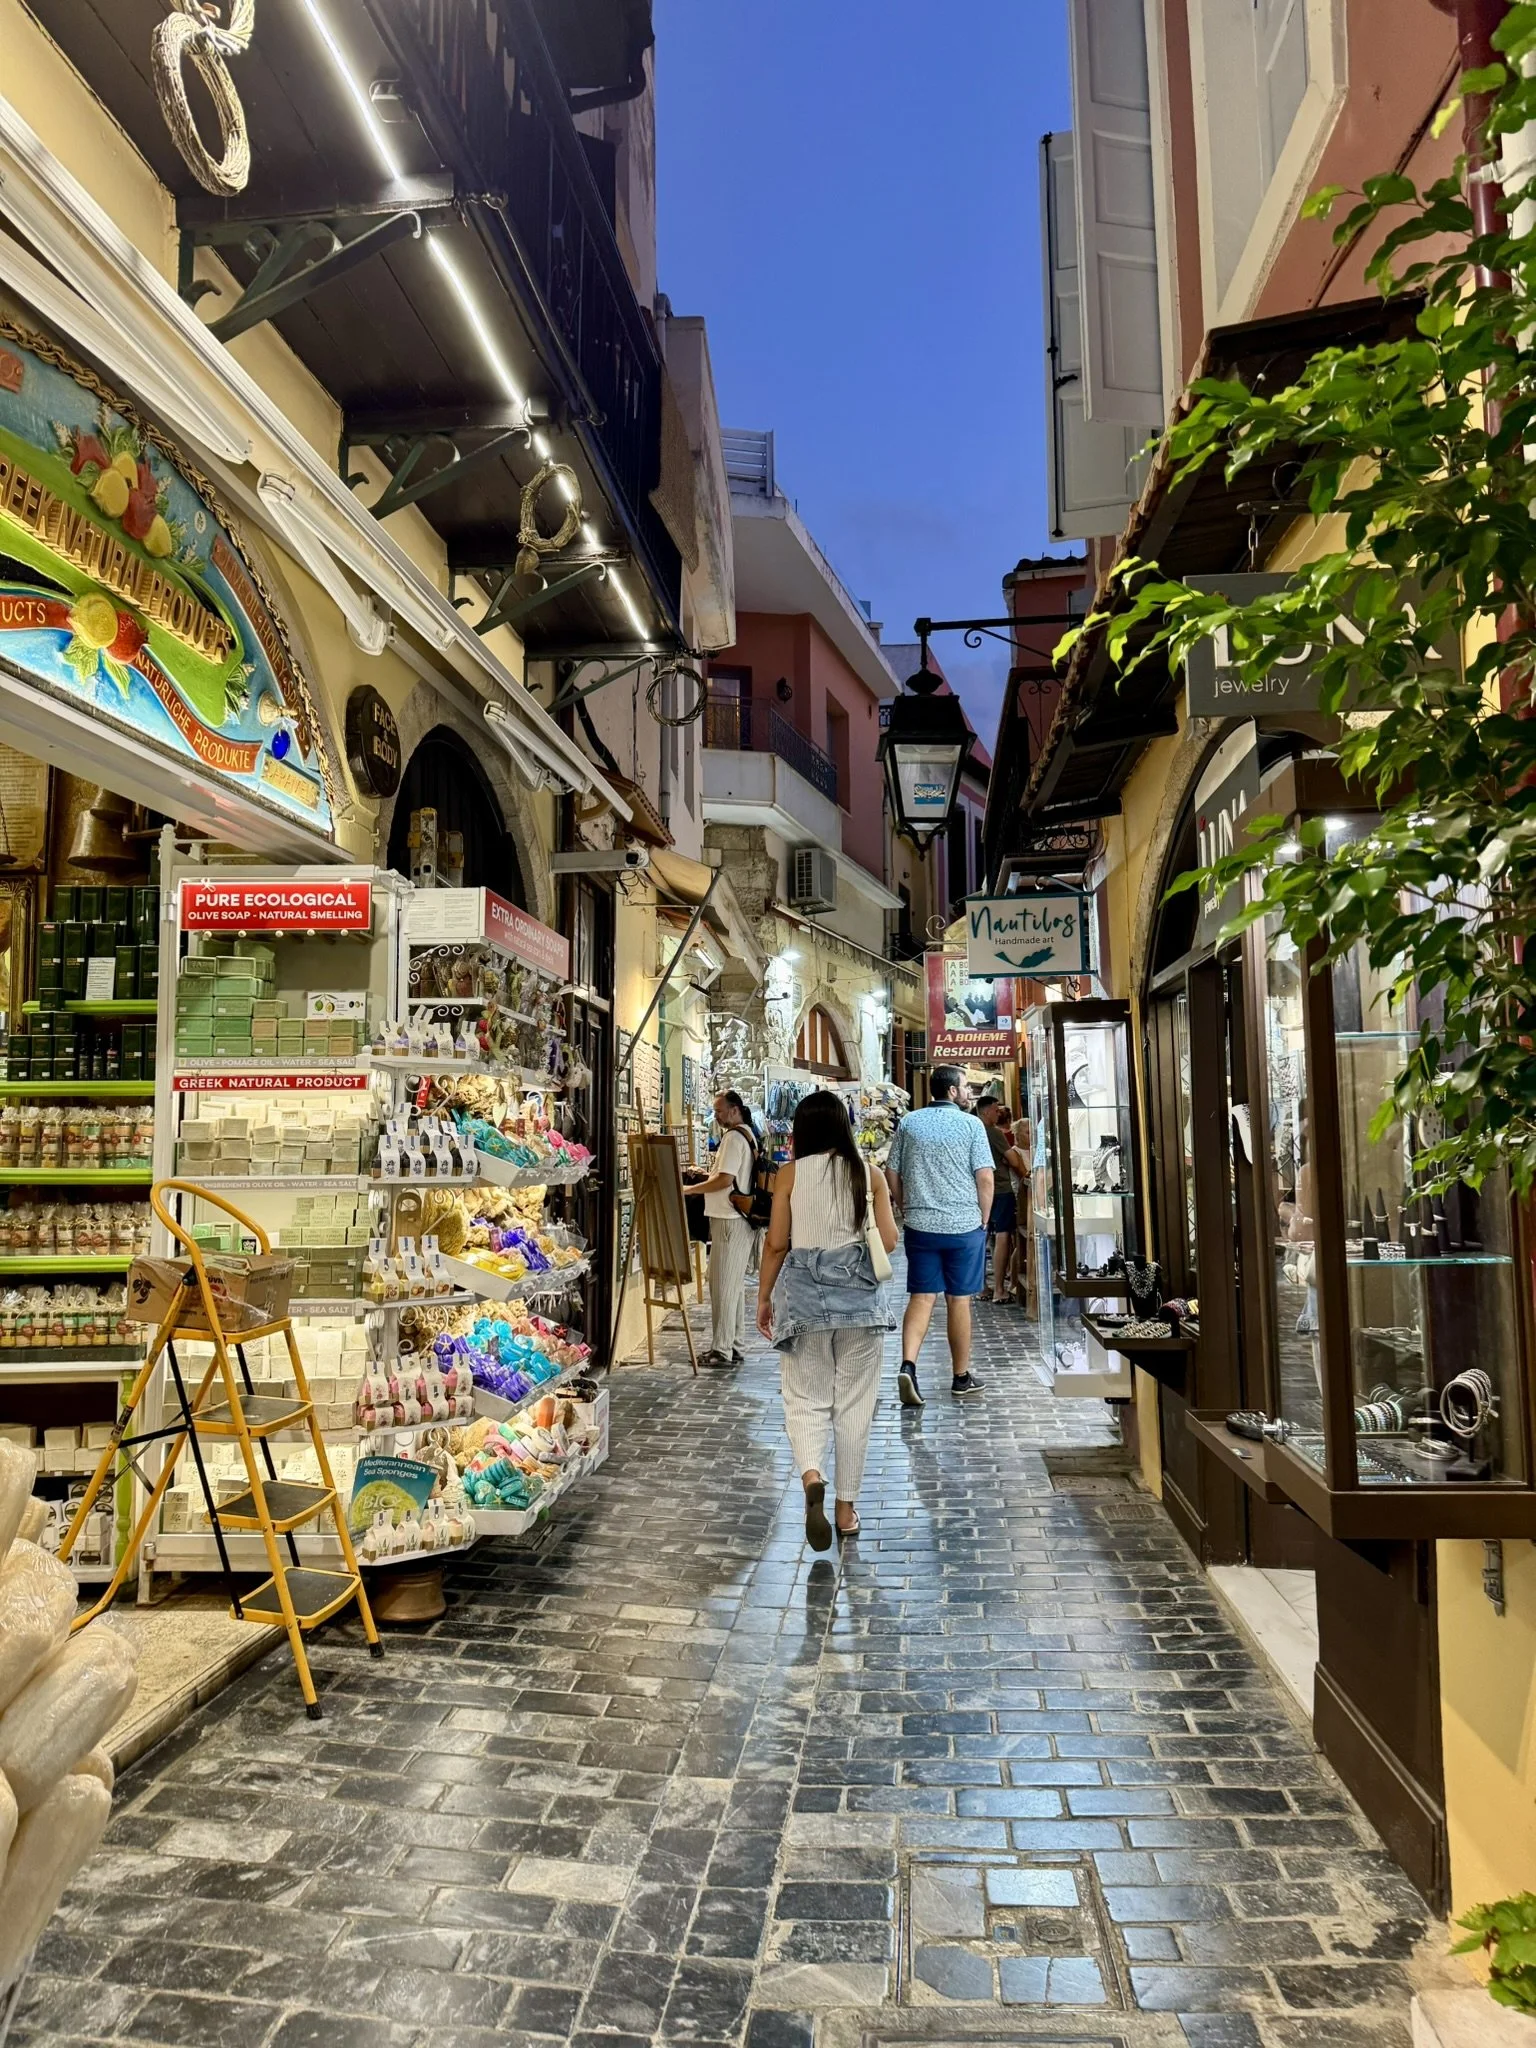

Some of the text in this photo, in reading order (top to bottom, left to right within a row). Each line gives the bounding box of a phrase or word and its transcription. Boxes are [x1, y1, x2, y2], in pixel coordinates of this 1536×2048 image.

[0, 452, 232, 665] REEK NATURAL PRODUCTS
[2, 601, 46, 624] UCTS
[244, 590, 258, 622] OIL
[258, 620, 288, 677] HONEY
[1213, 673, 1290, 698] jewelry
[135, 651, 251, 770] NATÜRLICHE PRODUKTE
[373, 702, 396, 736] FACE
[373, 735, 397, 769] BODY
[195, 892, 356, 907] PURE ECOLOGICAL
[188, 911, 219, 920] OLIVE
[221, 911, 250, 920] SOAP
[259, 911, 308, 920] NATURAL
[310, 910, 363, 920] SMELLING
[491, 902, 514, 929] EXTRA
[515, 915, 545, 949] ORDINARY
[971, 906, 1076, 940] Nautilos
[994, 936, 1054, 945] Handmade art
[936, 1032, 1008, 1043] LA BOHEME
[933, 1044, 1011, 1057] Restaurant
[190, 1058, 214, 1066] OLIVE
[222, 1058, 259, 1066] POMACE
[260, 1058, 274, 1066] OIL
[282, 1058, 311, 1066] WATER
[318, 1058, 335, 1066] SEA
[179, 1077, 361, 1089] GREEK NATURAL PRODUCT
[288, 1306, 302, 1314] TER
[309, 1305, 327, 1314] SEA
[328, 1305, 349, 1314] SALT
[363, 1459, 426, 1473] Mediterannean
[363, 1467, 419, 1479] Sea Sponges
